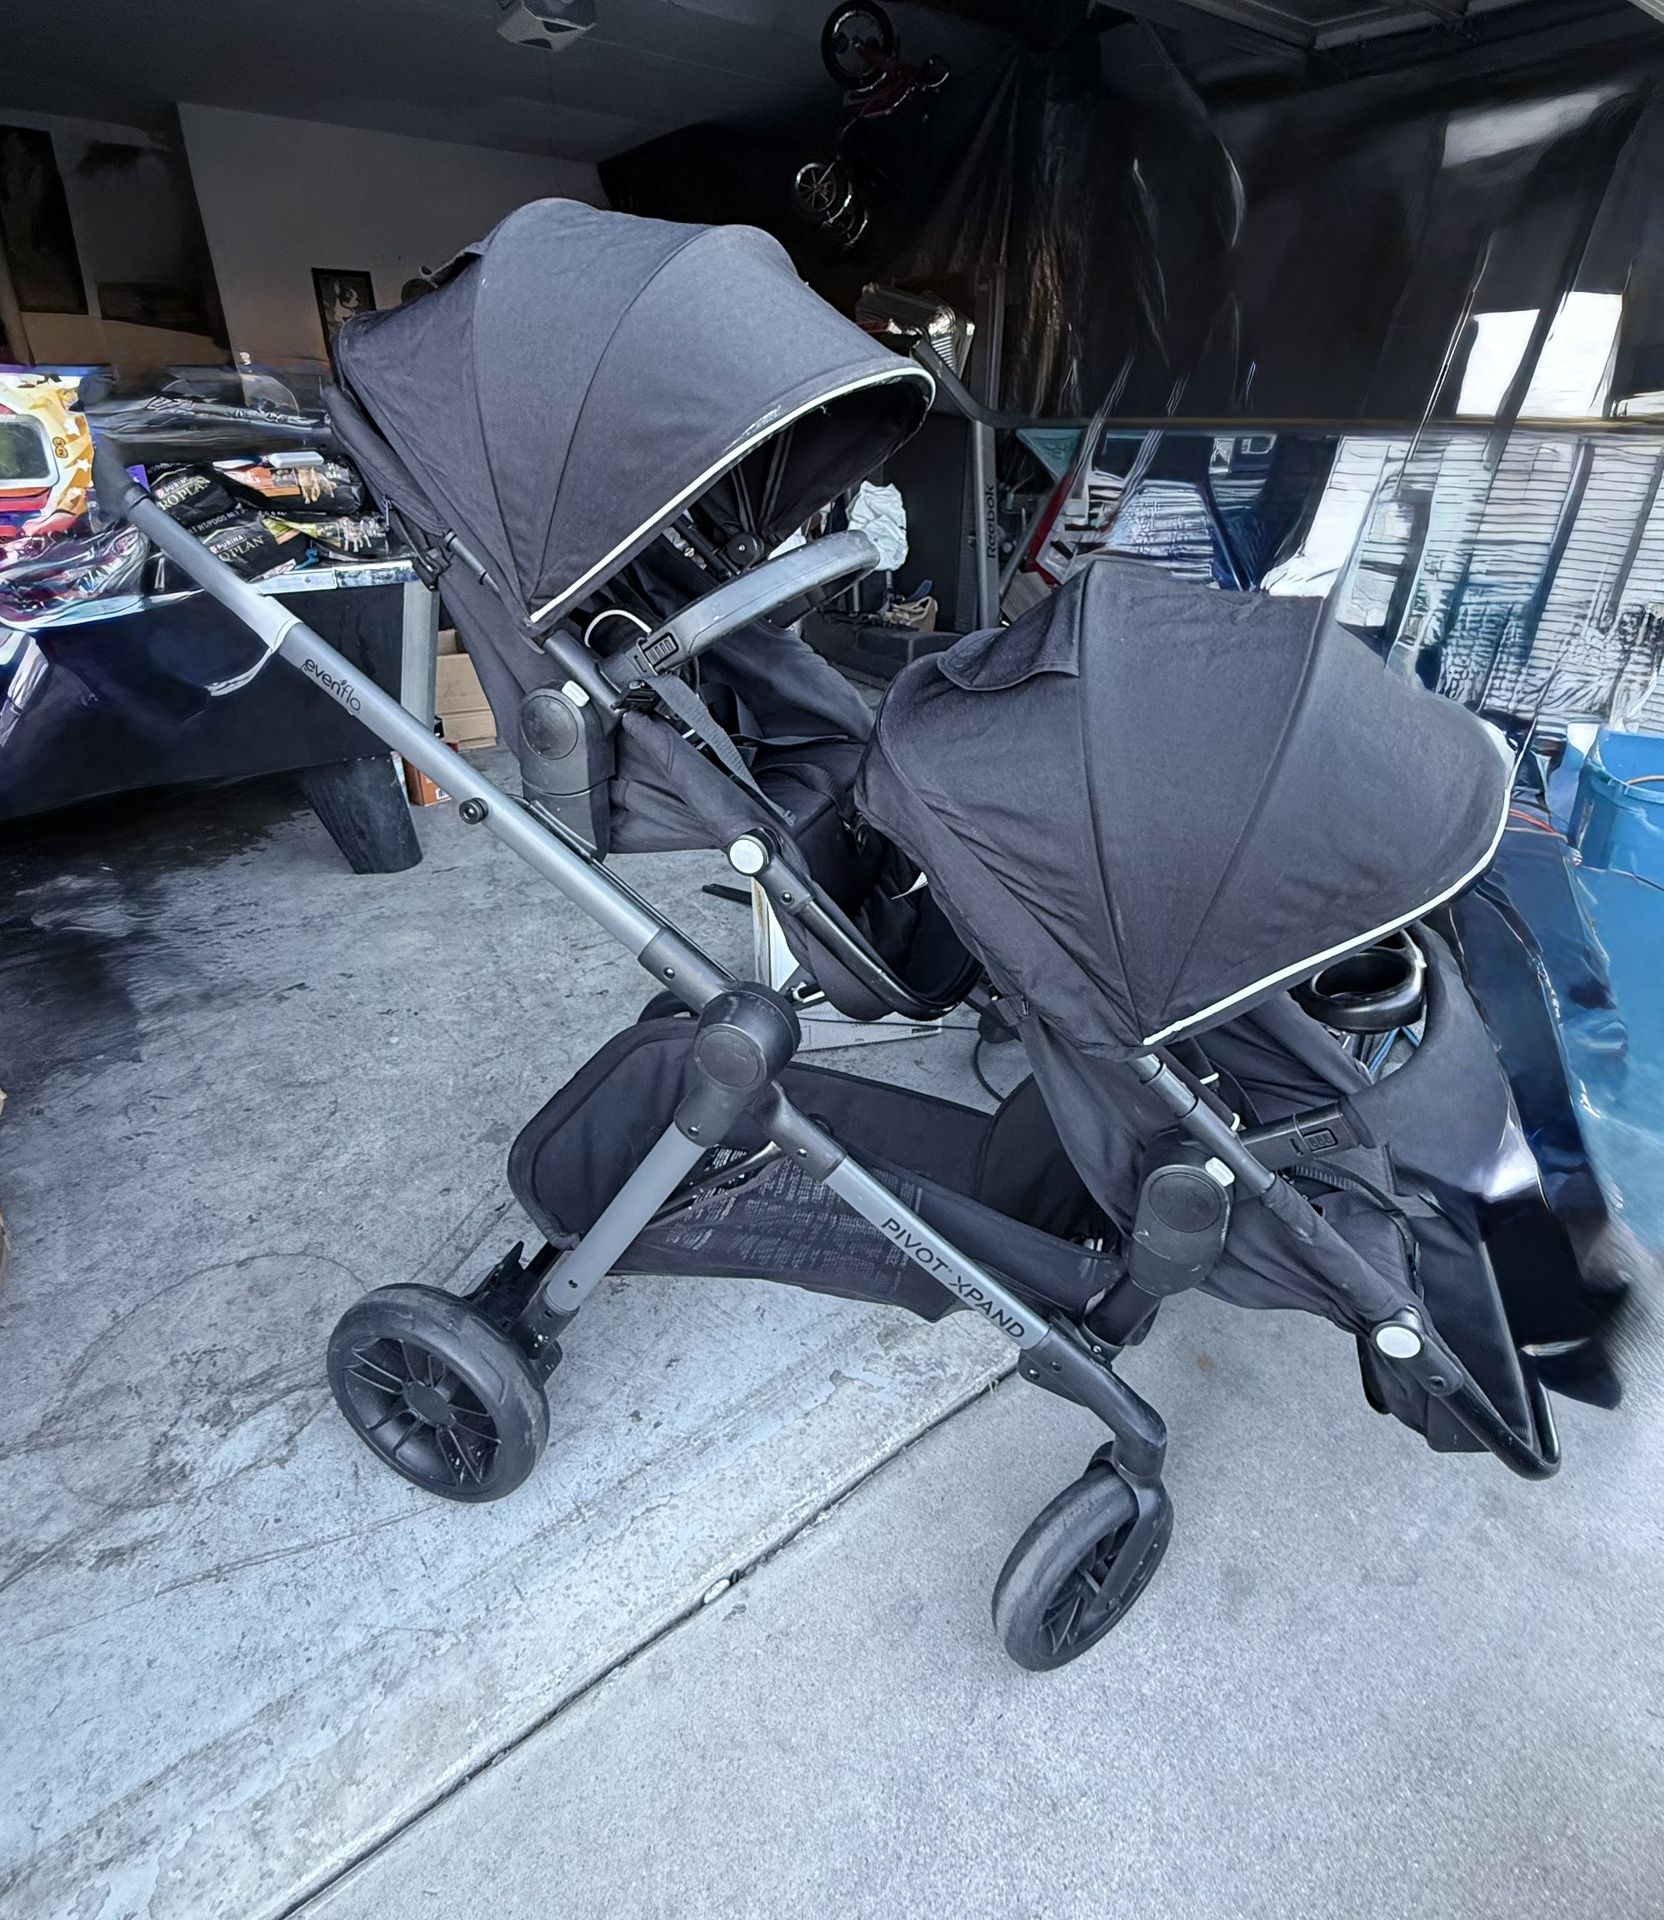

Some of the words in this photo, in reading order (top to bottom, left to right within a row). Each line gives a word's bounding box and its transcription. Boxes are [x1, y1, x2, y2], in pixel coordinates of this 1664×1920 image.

[985, 485, 997, 559] Reebok
[304, 658, 362, 712] evenflo
[881, 1217, 950, 1272] PIVOT
[948, 1275, 1026, 1339] XPAND
